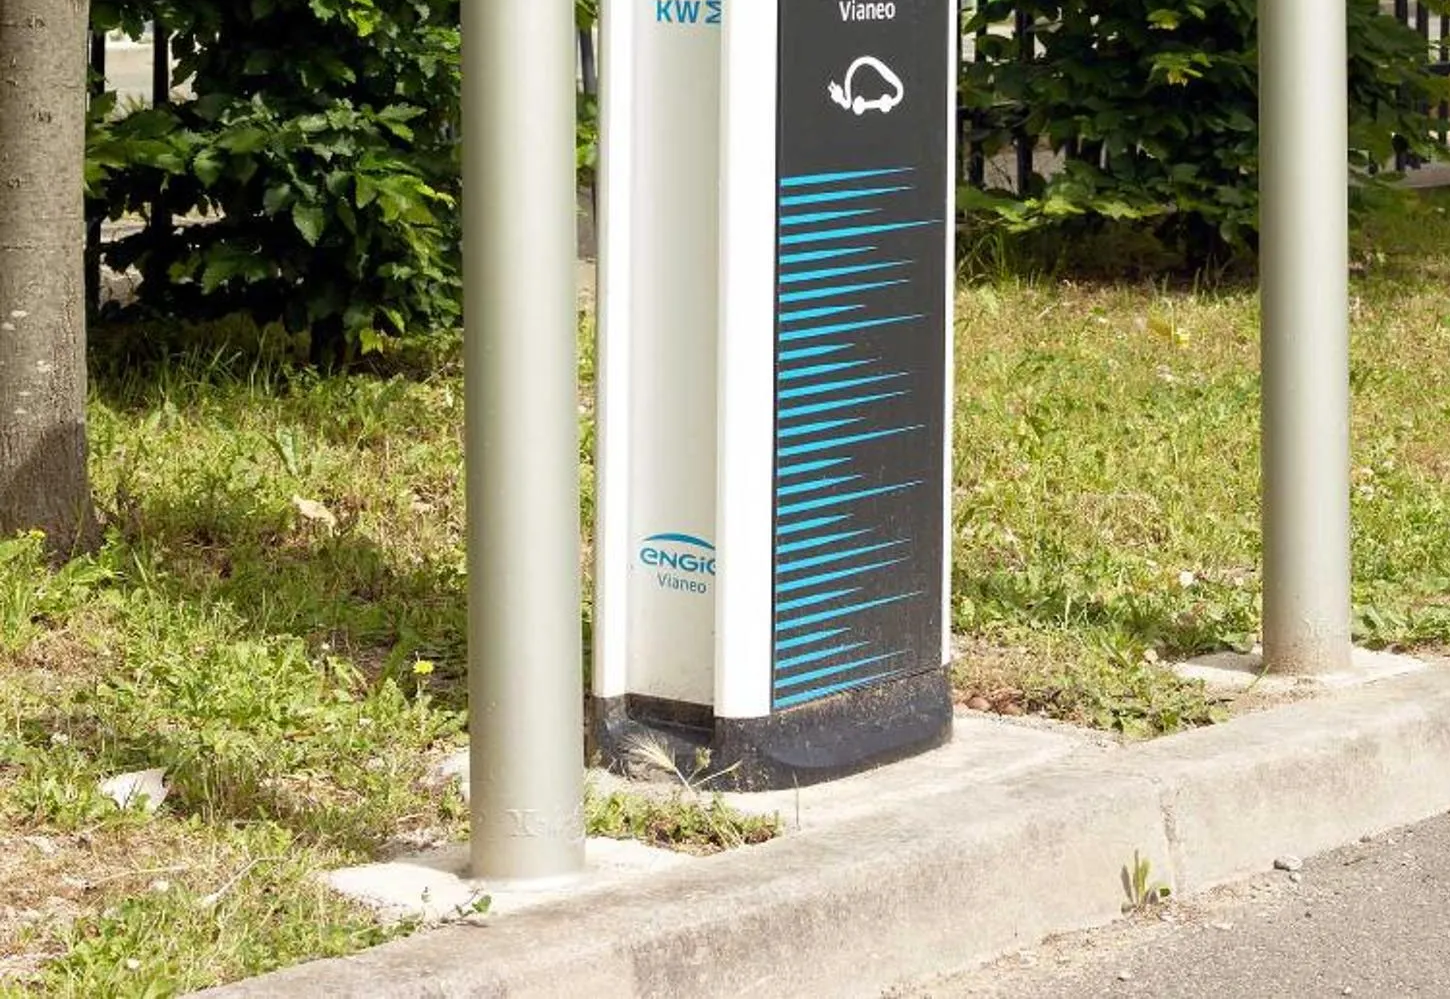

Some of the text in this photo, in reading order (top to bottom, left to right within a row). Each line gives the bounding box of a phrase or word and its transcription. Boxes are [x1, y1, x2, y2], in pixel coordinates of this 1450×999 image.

[656, 0, 699, 23] KW
[838, 0, 896, 22] Vianeo
[657, 571, 707, 594] Vianeo
